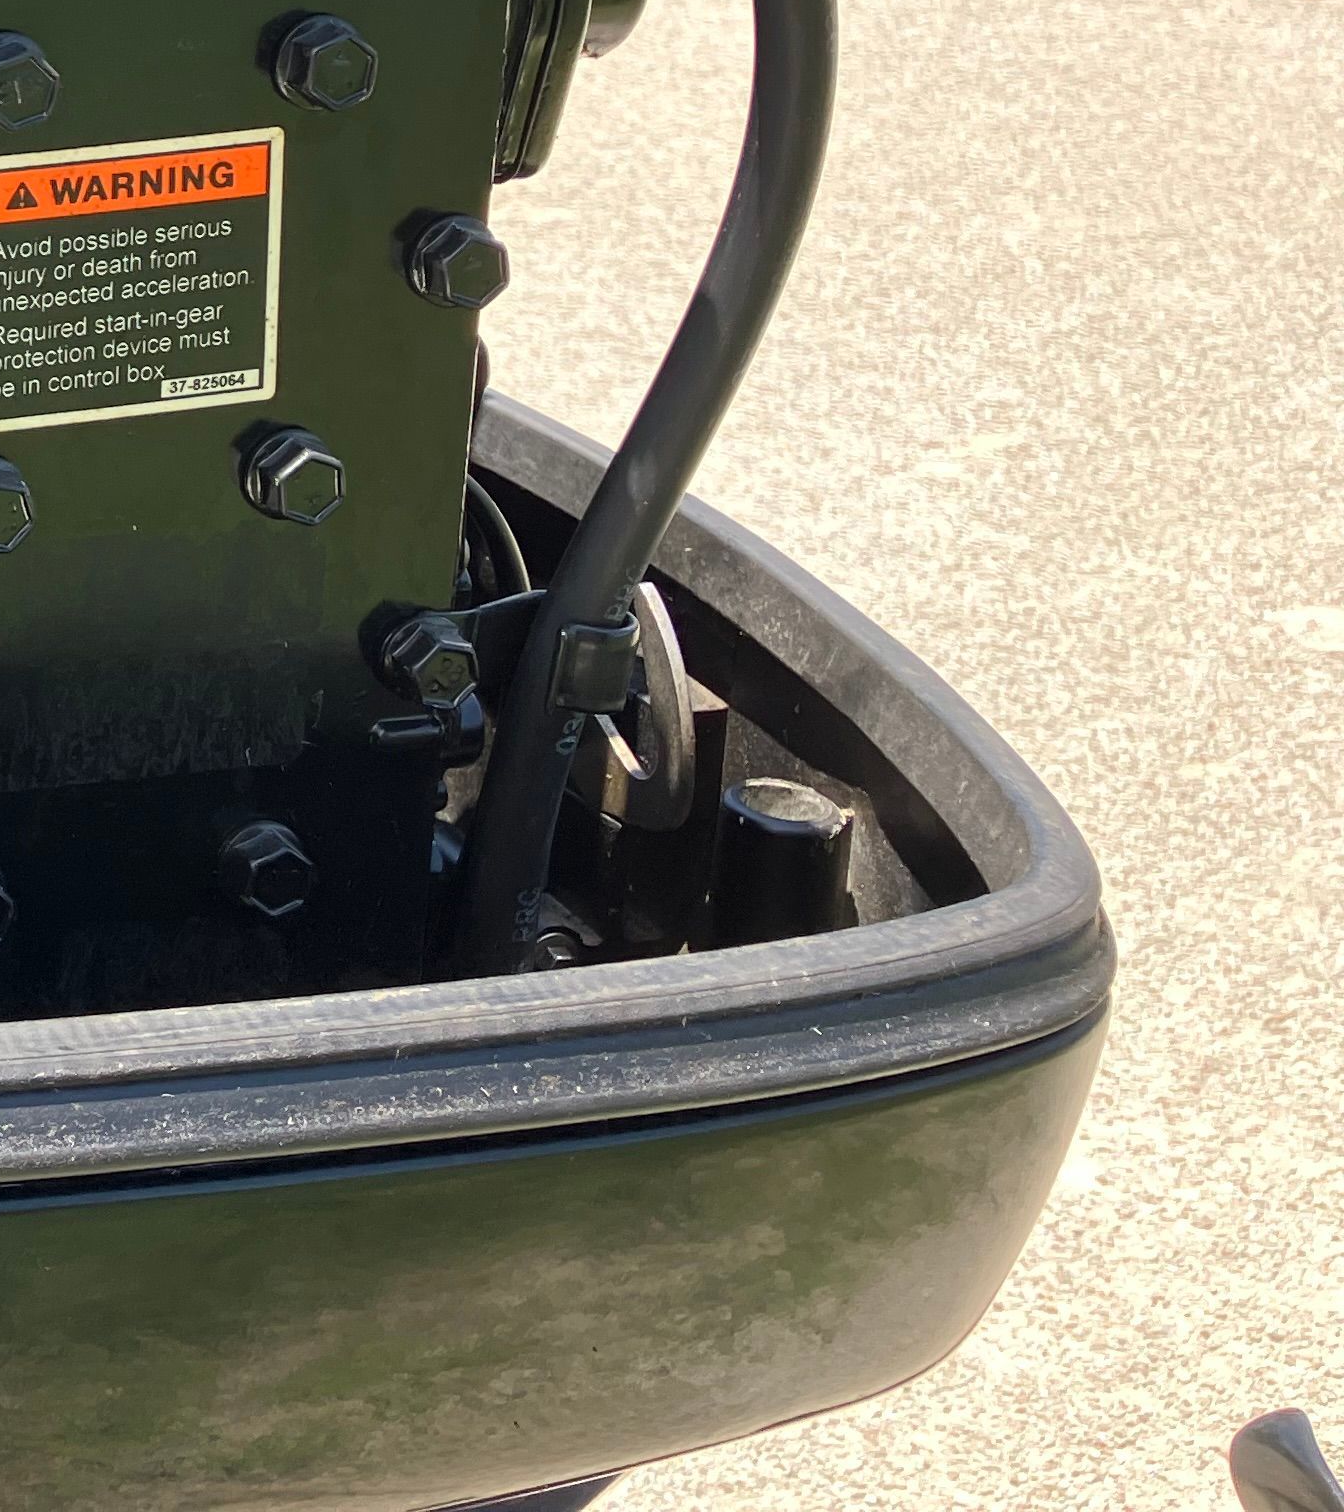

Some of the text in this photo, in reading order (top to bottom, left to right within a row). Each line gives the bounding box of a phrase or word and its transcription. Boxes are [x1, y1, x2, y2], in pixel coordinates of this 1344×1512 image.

[50, 161, 234, 205] WARNING
[59, 227, 147, 257] possible
[155, 219, 232, 243] serious
[53, 264, 76, 281] or
[82, 251, 142, 276] death
[150, 248, 197, 269] from
[94, 303, 224, 335] start-in-gear
[102, 335, 172, 359] device
[179, 328, 230, 349] must
[23, 375, 41, 394] in
[48, 365, 120, 392] control
[169, 374, 246, 394] 37-825064
